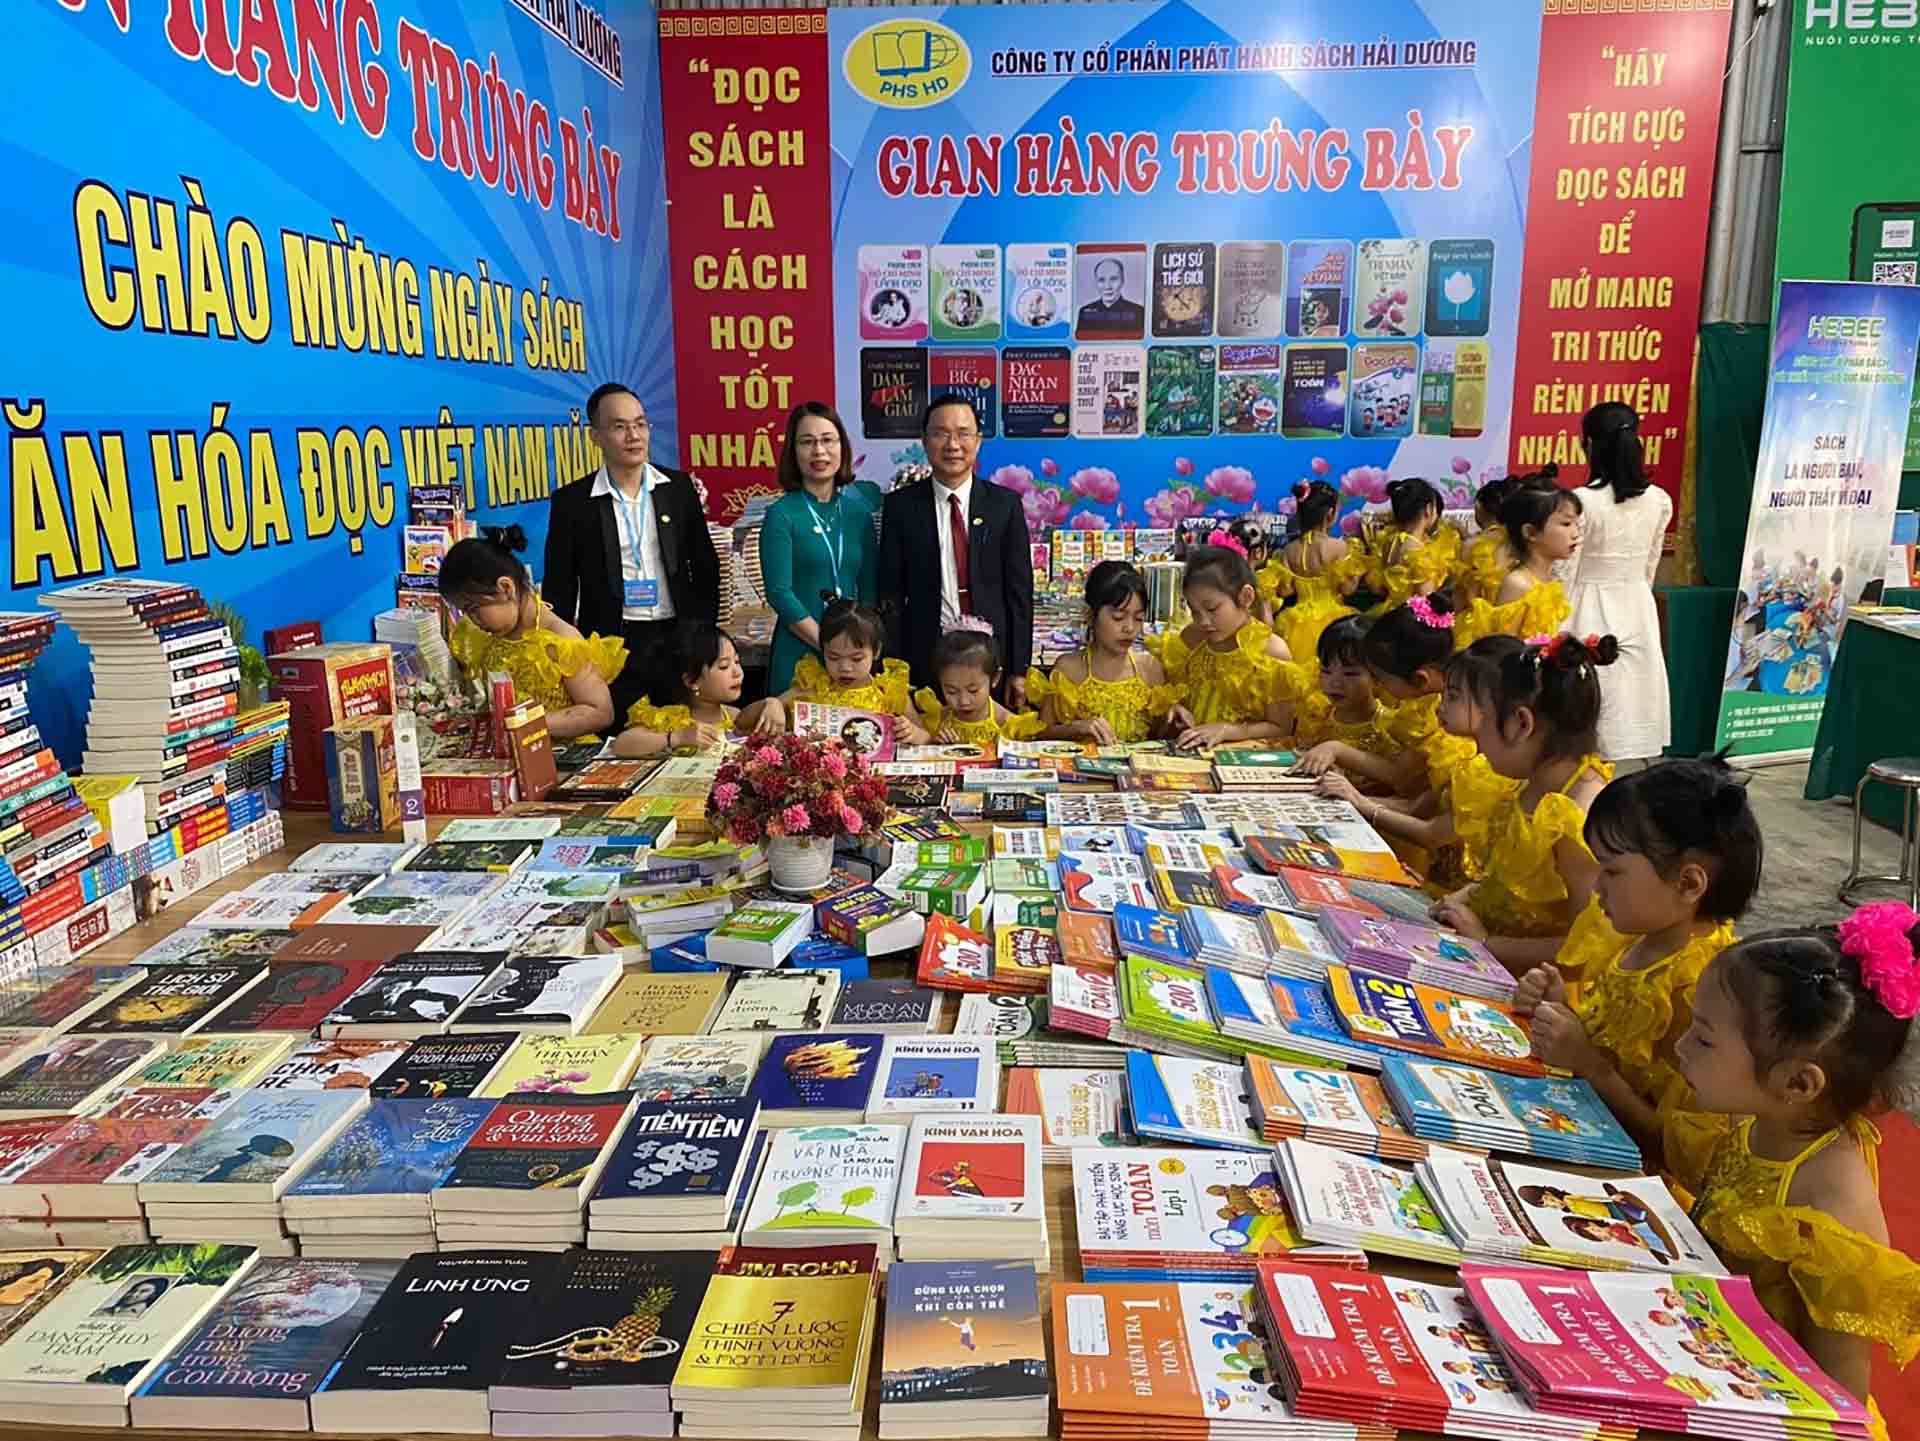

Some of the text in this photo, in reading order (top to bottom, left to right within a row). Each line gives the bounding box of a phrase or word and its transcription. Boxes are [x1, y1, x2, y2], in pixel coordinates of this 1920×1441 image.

[991, 34, 1476, 74] CÔNG TY CỔ PHẦN PHÁT HÀNH SÁCH HẢI DƯƠNG
[879, 76, 950, 99] PHS HD
[399, 19, 622, 241] TRƯNG BÀY
[1567, 106, 1686, 152] TÍCH CỰC
[688, 124, 805, 167] SÁCH
[878, 109, 1473, 198] GIAN HÀNG TRƯNG BÀY
[1555, 160, 1687, 207] ĐỌC SÁCH
[723, 185, 775, 229] LÀ
[1599, 209, 1637, 254] ĐỂ
[74, 174, 588, 374] CHÀO MỪNG NGÀY SÁCH
[693, 248, 807, 291] CÁCH
[1549, 267, 1673, 309] MỞ MANG
[710, 314, 794, 358] HỌC
[1551, 323, 1663, 361] TRI THỨC
[719, 363, 794, 409] TỐT
[1533, 378, 1584, 414] RÈN
[148, 403, 291, 562] HÓA
[296, 425, 396, 554] ĐỌC
[487, 423, 552, 508] NAM
[406, 799, 419, 815] 2
[1169, 984, 1198, 1012] 500
[1368, 980, 1405, 997] 2
[1299, 1069, 1338, 1087] 2
[1433, 1067, 1475, 1083] 2
[992, 1127, 1024, 1137] HOA
[1123, 1162, 1156, 1215] TOÁN
[1010, 1202, 1025, 1213] 7
[406, 1274, 530, 1293] LINH ỨNG
[735, 1259, 857, 1277] JIM ROHN
[1120, 1297, 1161, 1312] 1
[1330, 1281, 1371, 1297] 1
[1537, 1282, 1582, 1299] 1
[705, 1319, 777, 1336] CHIẾN
[773, 1300, 796, 1324] 7
[695, 1353, 711, 1365] &
[704, 1339, 762, 1352] THỊNH
